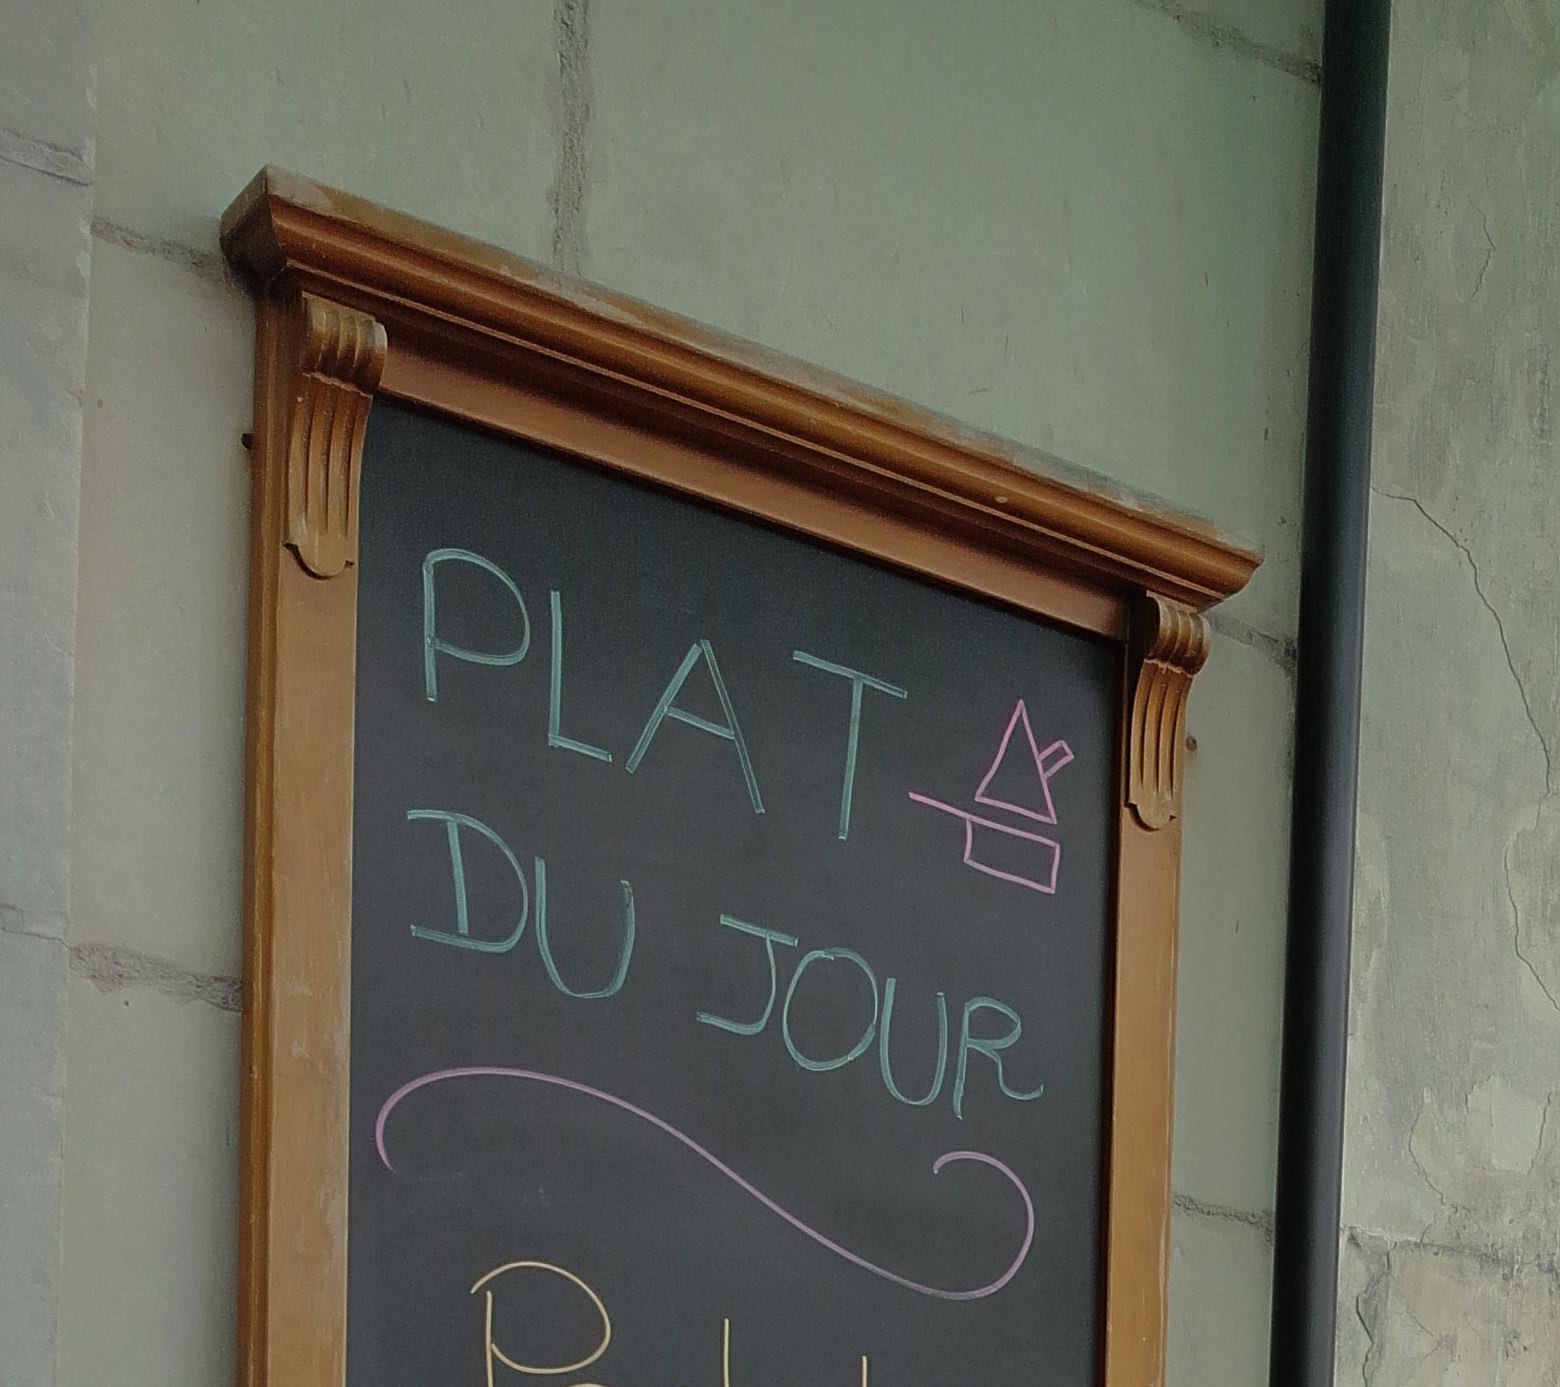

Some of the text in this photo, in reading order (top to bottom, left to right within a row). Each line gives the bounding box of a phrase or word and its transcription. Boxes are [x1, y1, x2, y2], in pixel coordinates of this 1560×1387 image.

[423, 547, 908, 840] PLAT
[407, 809, 1043, 1119] DU JOUR
